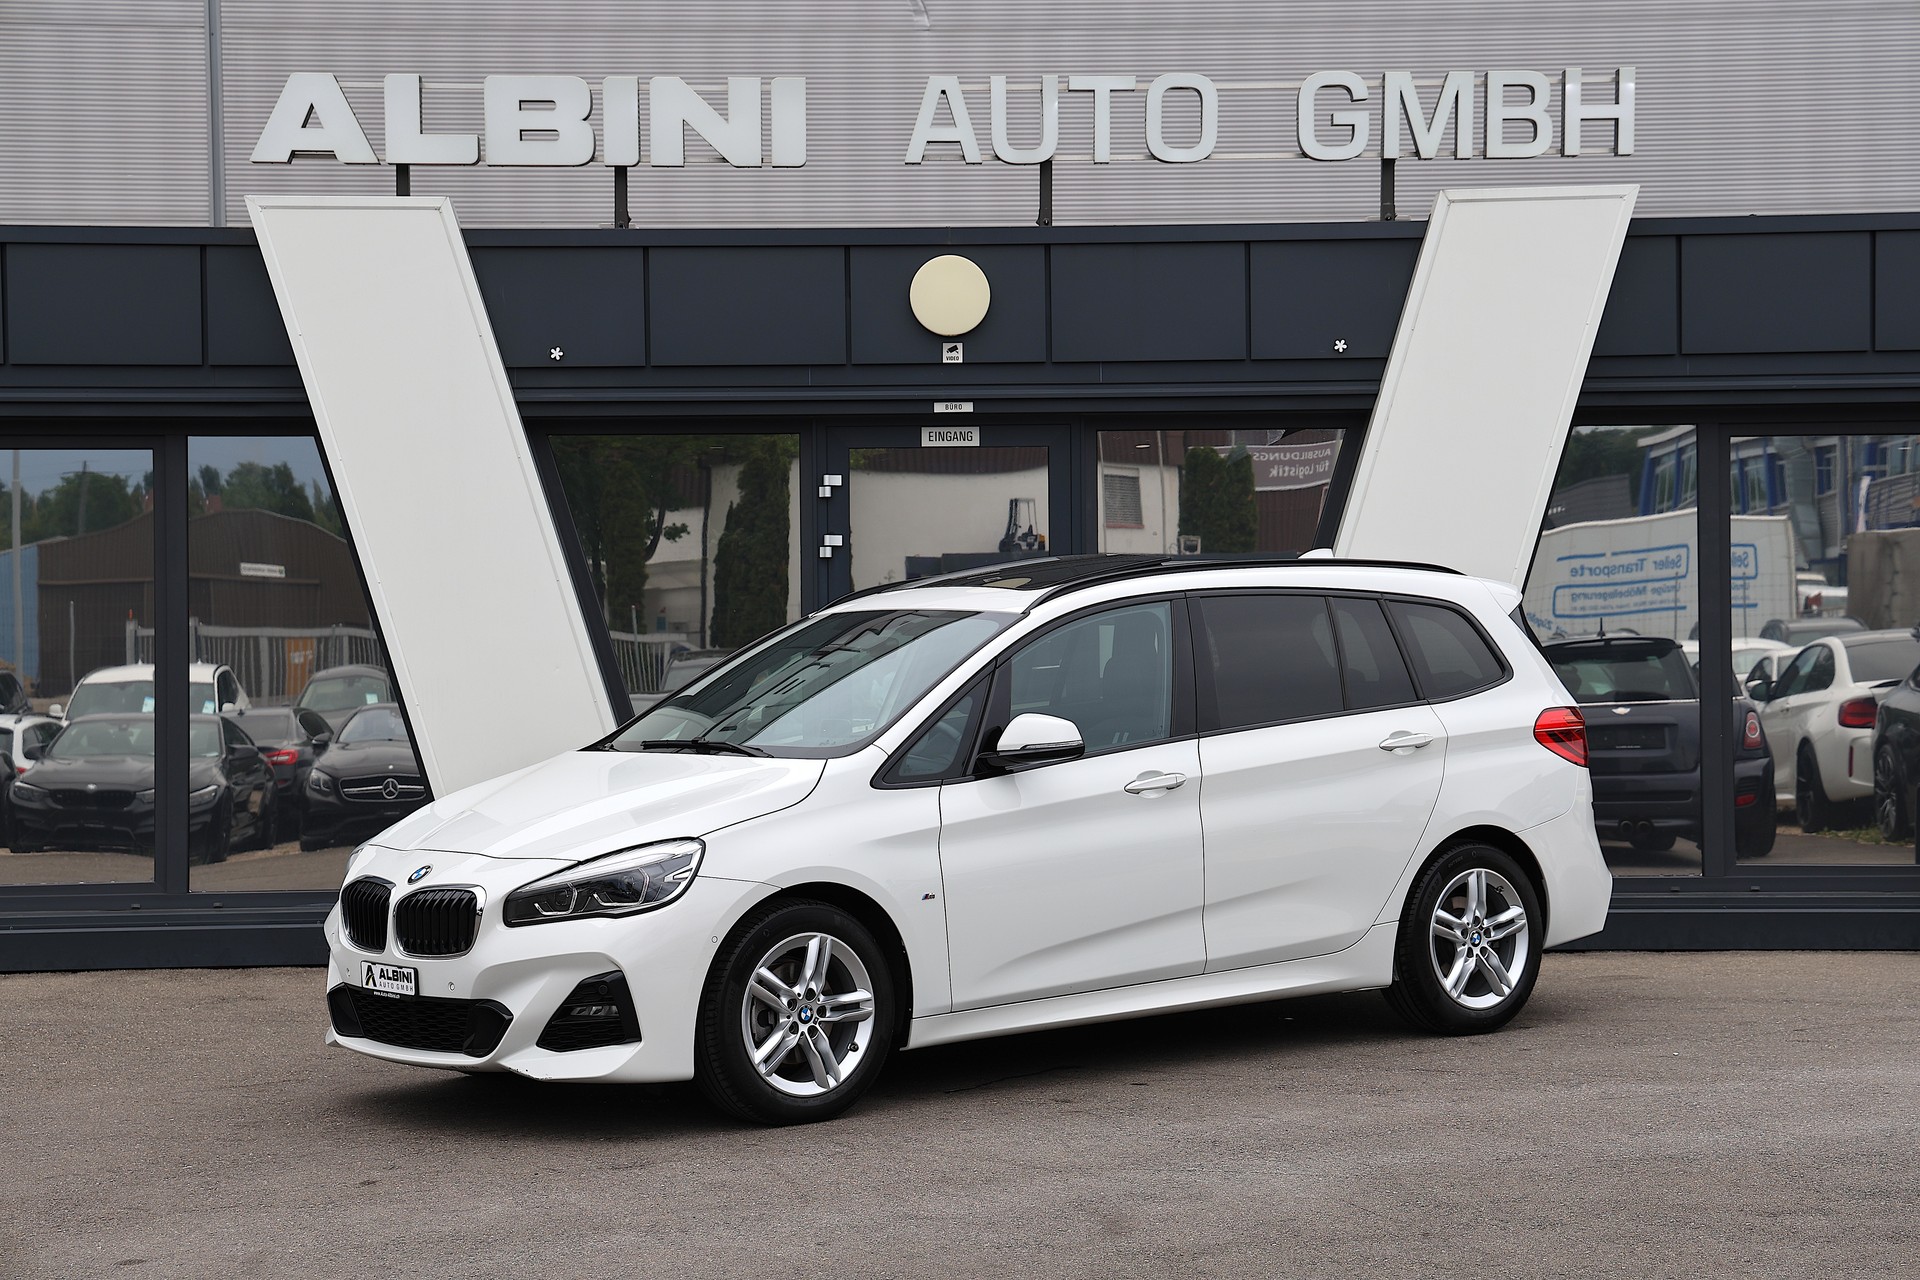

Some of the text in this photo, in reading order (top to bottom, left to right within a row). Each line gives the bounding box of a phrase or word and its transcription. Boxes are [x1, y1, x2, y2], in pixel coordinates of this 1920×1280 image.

[249, 67, 1637, 168] ALBINI AUTO GMBH
[945, 402, 963, 411] BÜRO
[928, 431, 973, 442] EINGANG
[379, 968, 412, 983] ALBINI
[380, 981, 413, 992] AUTO GMBH
